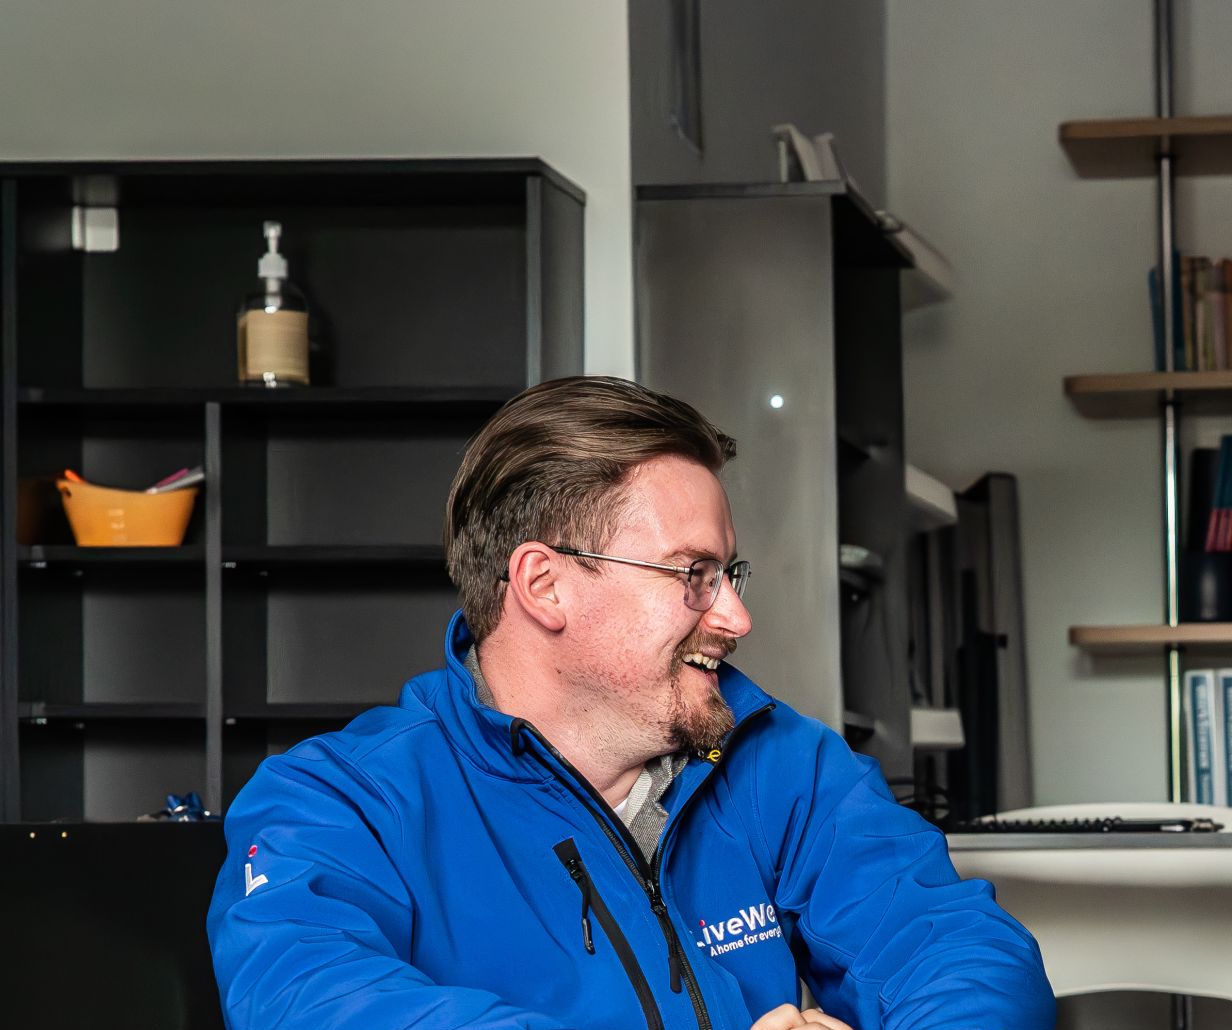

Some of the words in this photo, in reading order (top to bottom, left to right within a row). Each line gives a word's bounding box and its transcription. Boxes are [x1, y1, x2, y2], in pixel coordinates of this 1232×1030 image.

[710, 946, 718, 957] A
[717, 939, 745, 955] home
[744, 933, 758, 946] for
